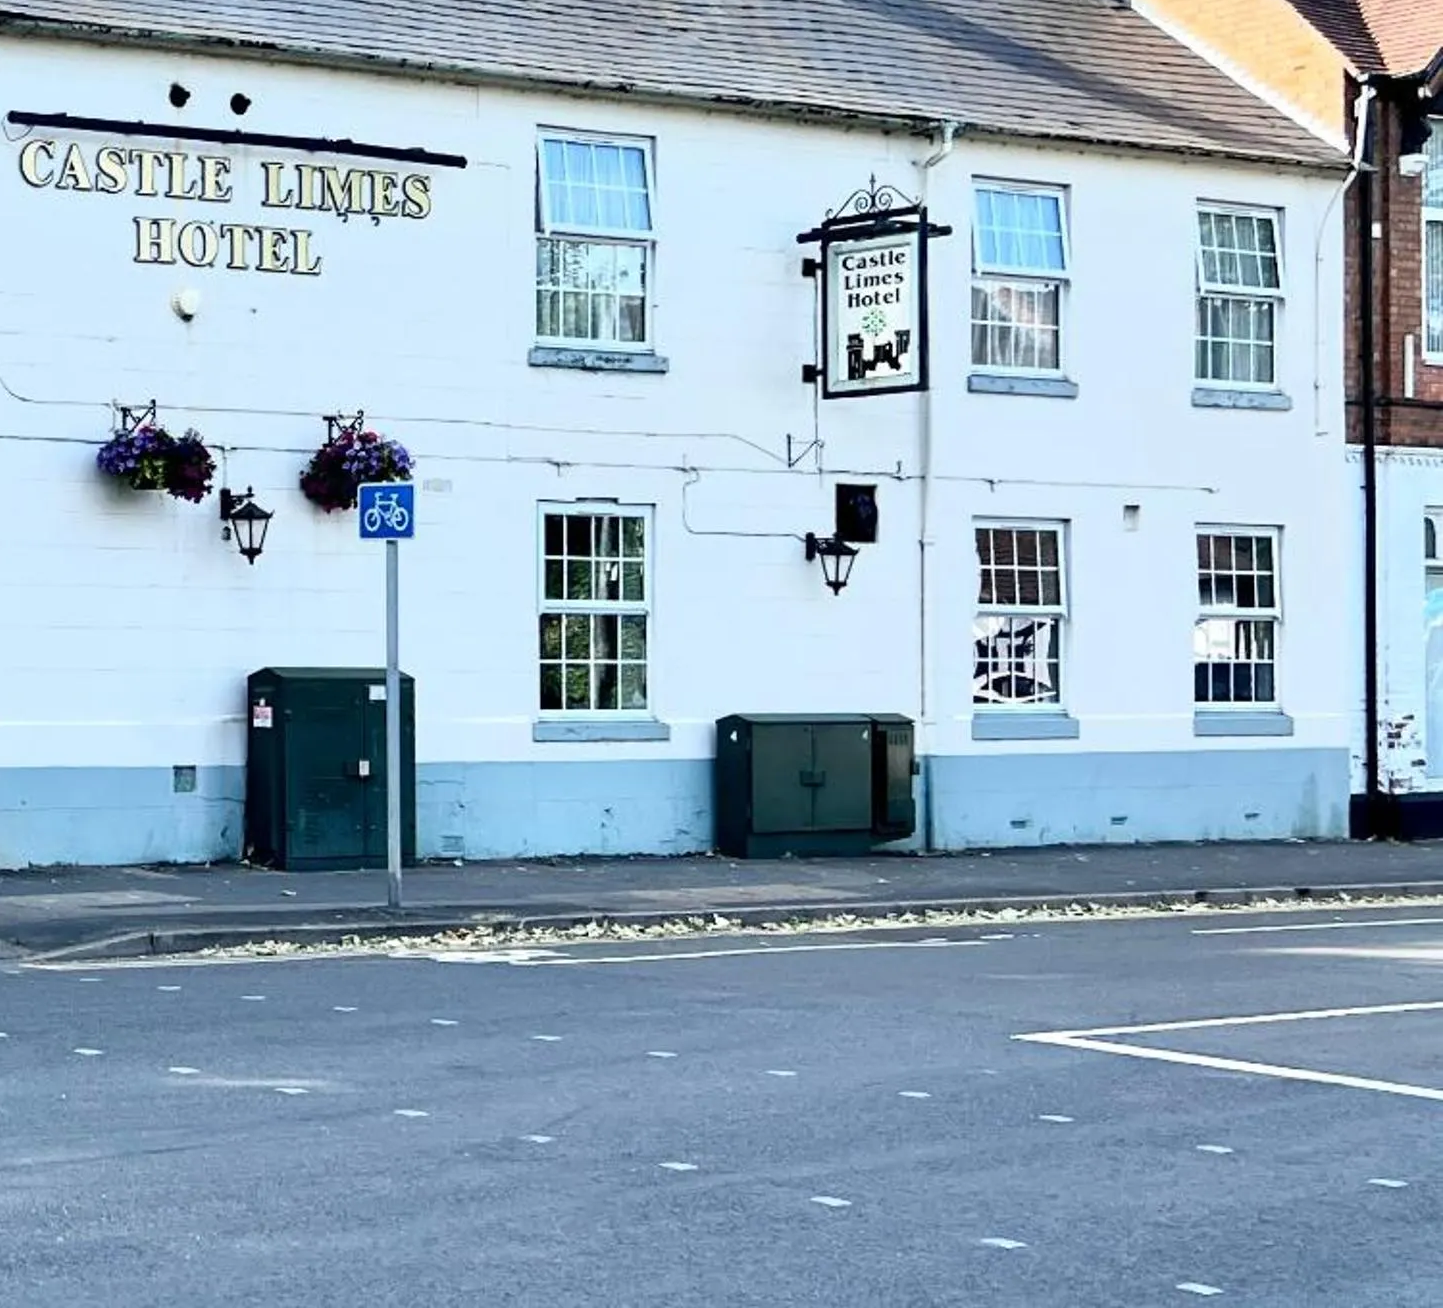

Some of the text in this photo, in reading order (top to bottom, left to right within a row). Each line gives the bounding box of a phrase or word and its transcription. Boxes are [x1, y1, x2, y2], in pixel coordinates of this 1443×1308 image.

[19, 139, 432, 219] CASTLE LIMES
[132, 216, 321, 276] HOTEL
[842, 250, 906, 271] Castle
[844, 272, 904, 291] Limes
[847, 287, 900, 308] Hotel
